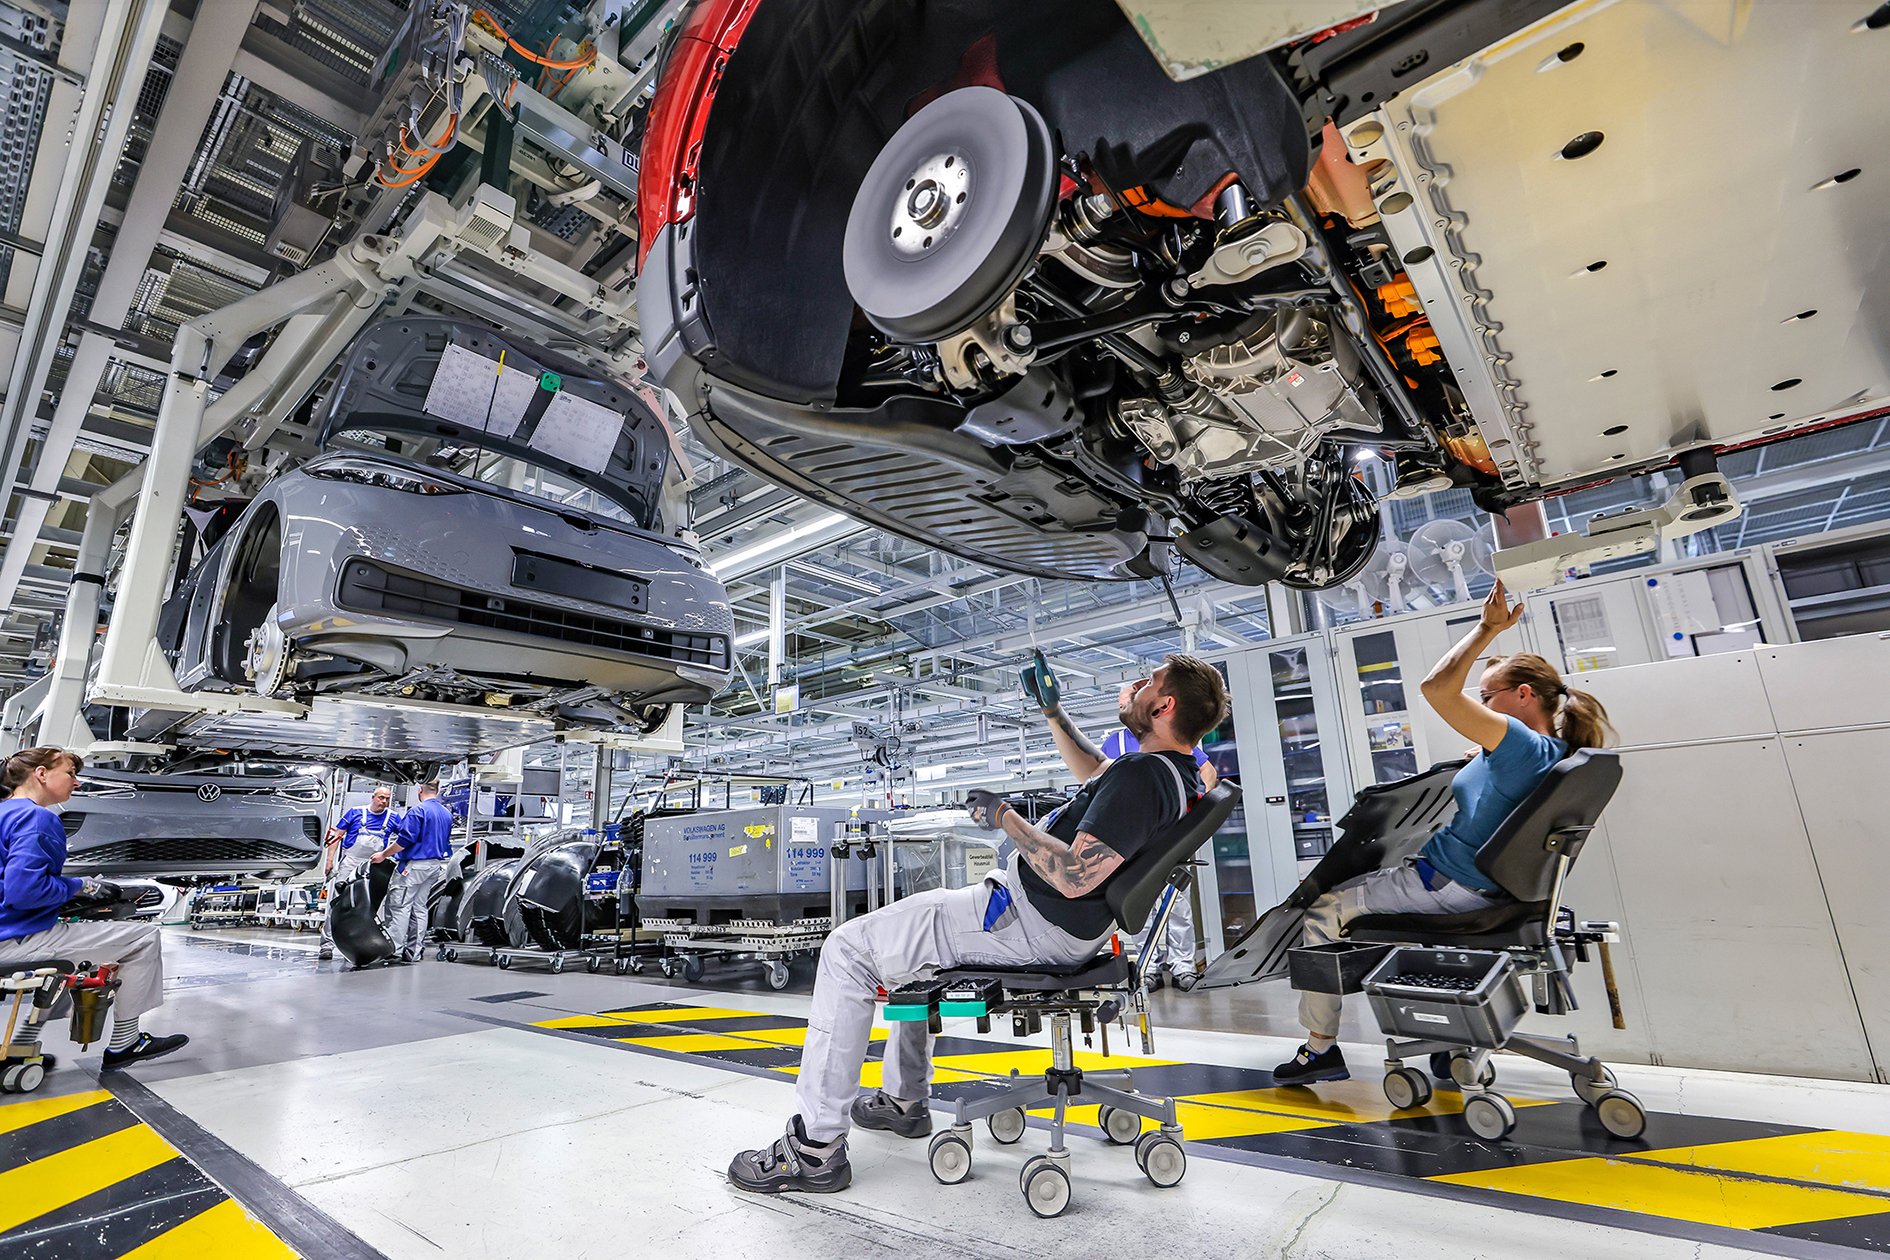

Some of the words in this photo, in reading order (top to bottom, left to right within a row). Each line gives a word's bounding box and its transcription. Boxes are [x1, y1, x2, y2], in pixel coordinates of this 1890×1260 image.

[855, 725, 868, 736] 152
[684, 824, 717, 834] VOLKSWAGEN
[717, 823, 726, 831] AG
[689, 852, 702, 863] 114
[702, 851, 717, 863] 999
[786, 847, 804, 859] 114
[805, 847, 825, 859] 999
